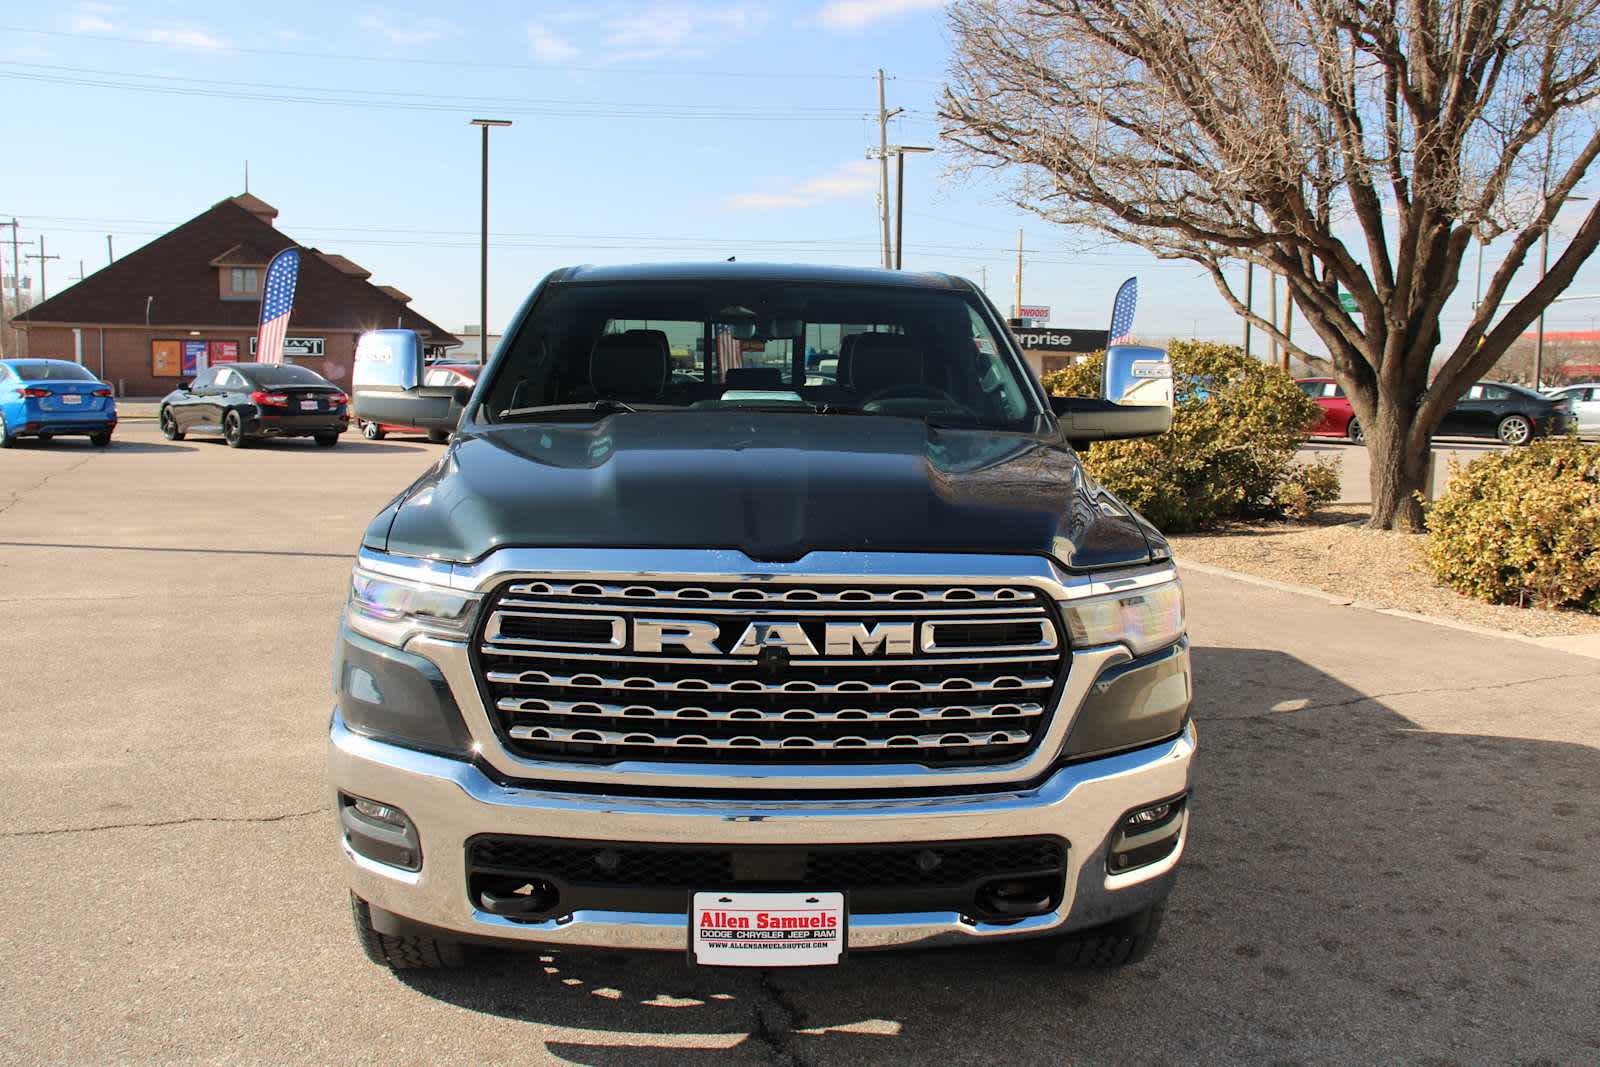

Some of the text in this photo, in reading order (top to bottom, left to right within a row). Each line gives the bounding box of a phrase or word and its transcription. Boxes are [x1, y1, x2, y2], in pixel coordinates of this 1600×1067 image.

[633, 618, 914, 655] RAM
[700, 911, 837, 929] Allen Samuels
[701, 930, 733, 938] DODGE
[736, 931, 784, 939] CHRYSLER
[813, 930, 835, 938] RAM
